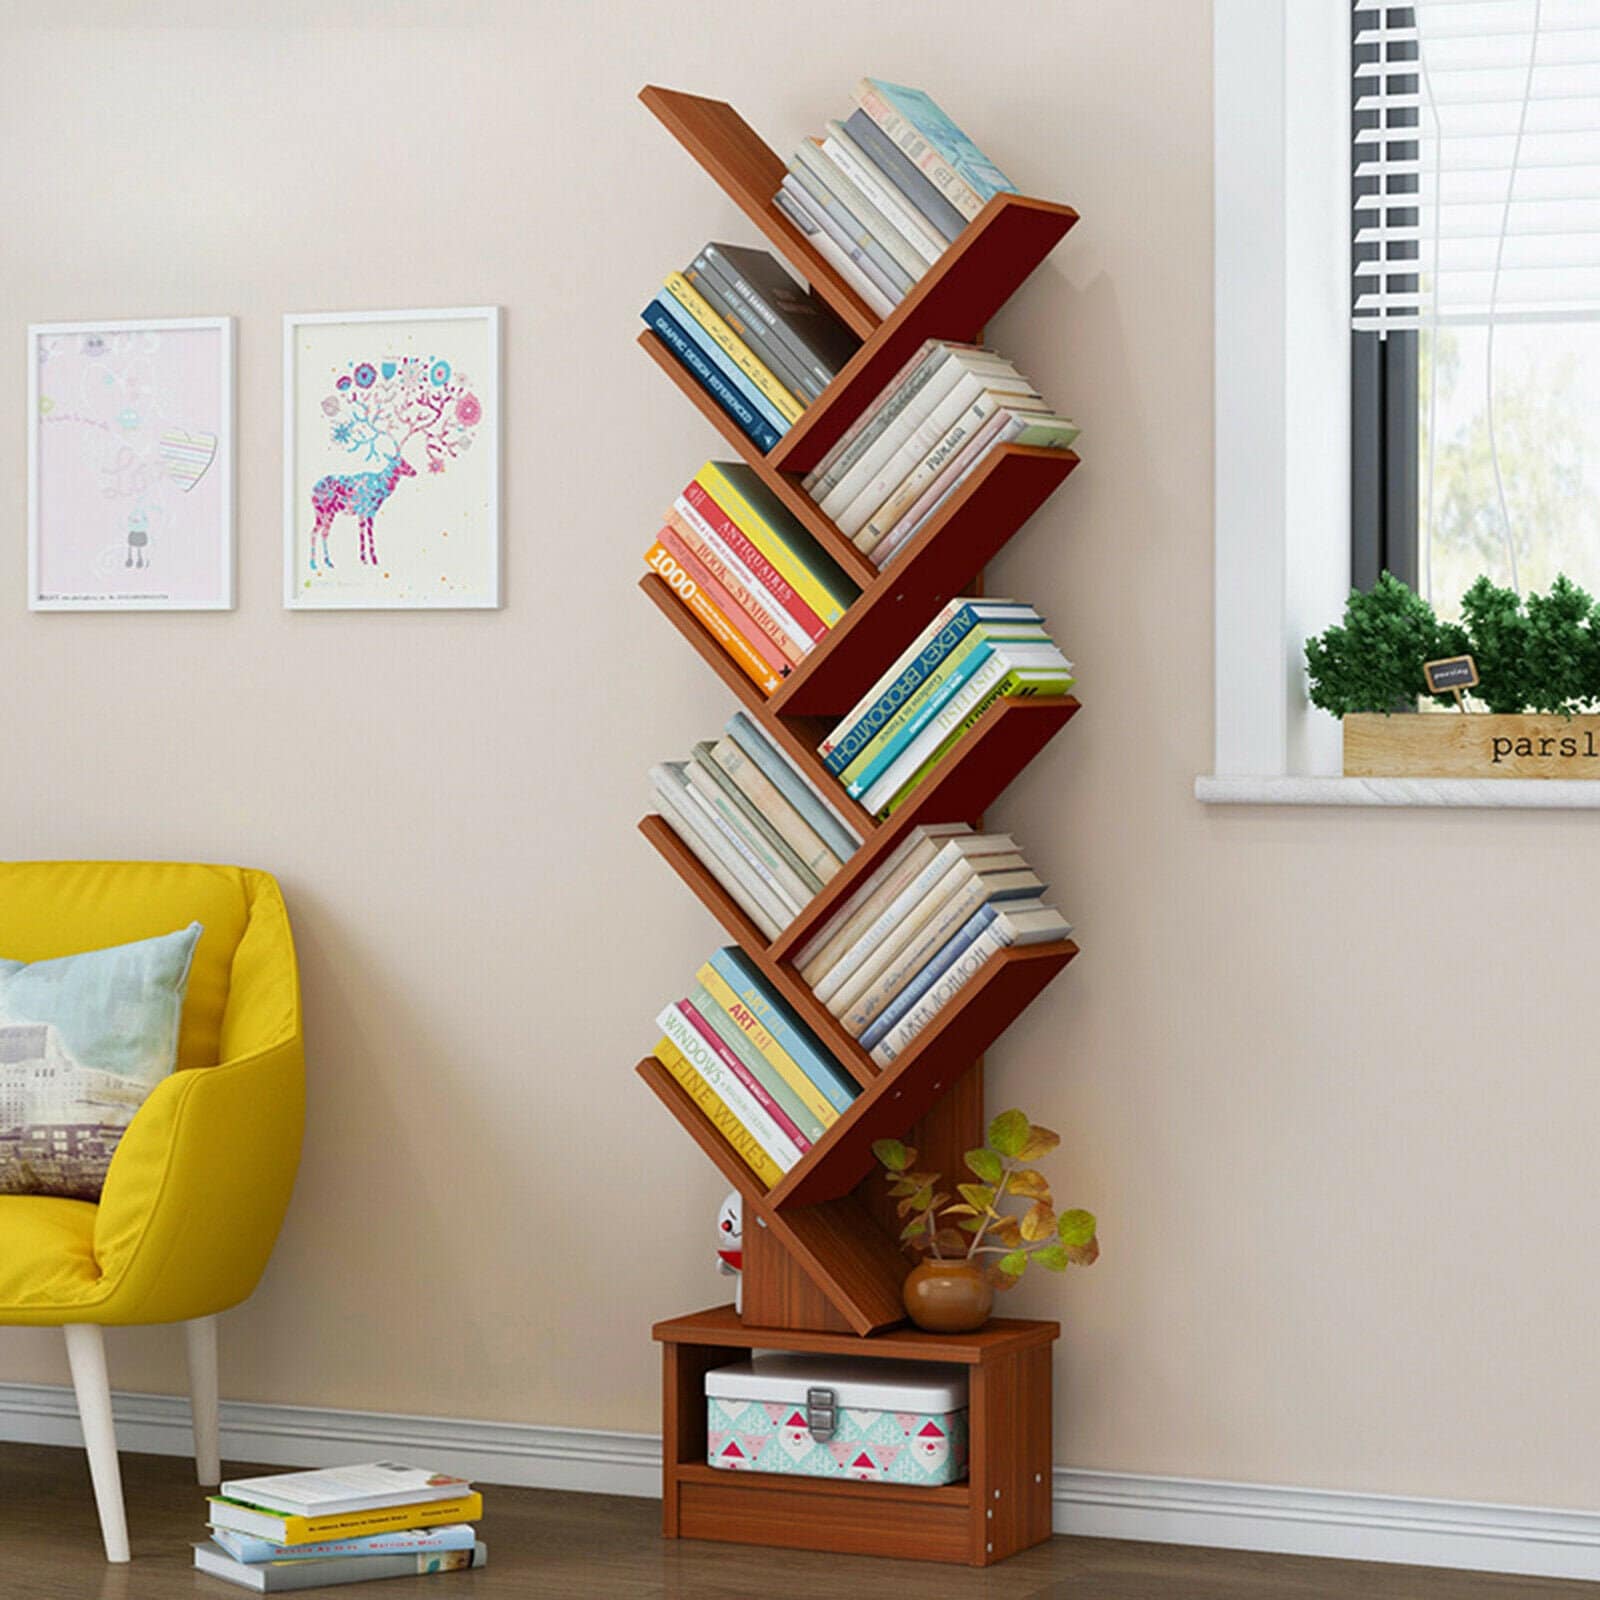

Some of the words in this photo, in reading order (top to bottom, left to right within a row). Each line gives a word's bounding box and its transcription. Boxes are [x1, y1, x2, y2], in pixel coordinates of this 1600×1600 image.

[655, 316, 688, 351] GRAPHIC
[683, 348, 711, 378] DESIGN
[707, 374, 753, 425] REFERENCED
[646, 546, 700, 601] 1000
[719, 518, 795, 601] ANTIQUAIRES
[693, 542, 732, 581] BOOK
[730, 584, 793, 647] SYMBOLS
[913, 607, 976, 674] ALEXEY
[910, 672, 944, 707] Gardens
[965, 654, 1005, 696] LOST
[877, 714, 906, 744] France
[901, 705, 914, 718] in
[934, 691, 972, 731] FISH
[726, 1000, 758, 1033] ART
[741, 986, 771, 1017] ART
[659, 1011, 728, 1084] WINDOWS
[670, 1056, 715, 1104] FINE
[709, 1102, 773, 1170] WINES
